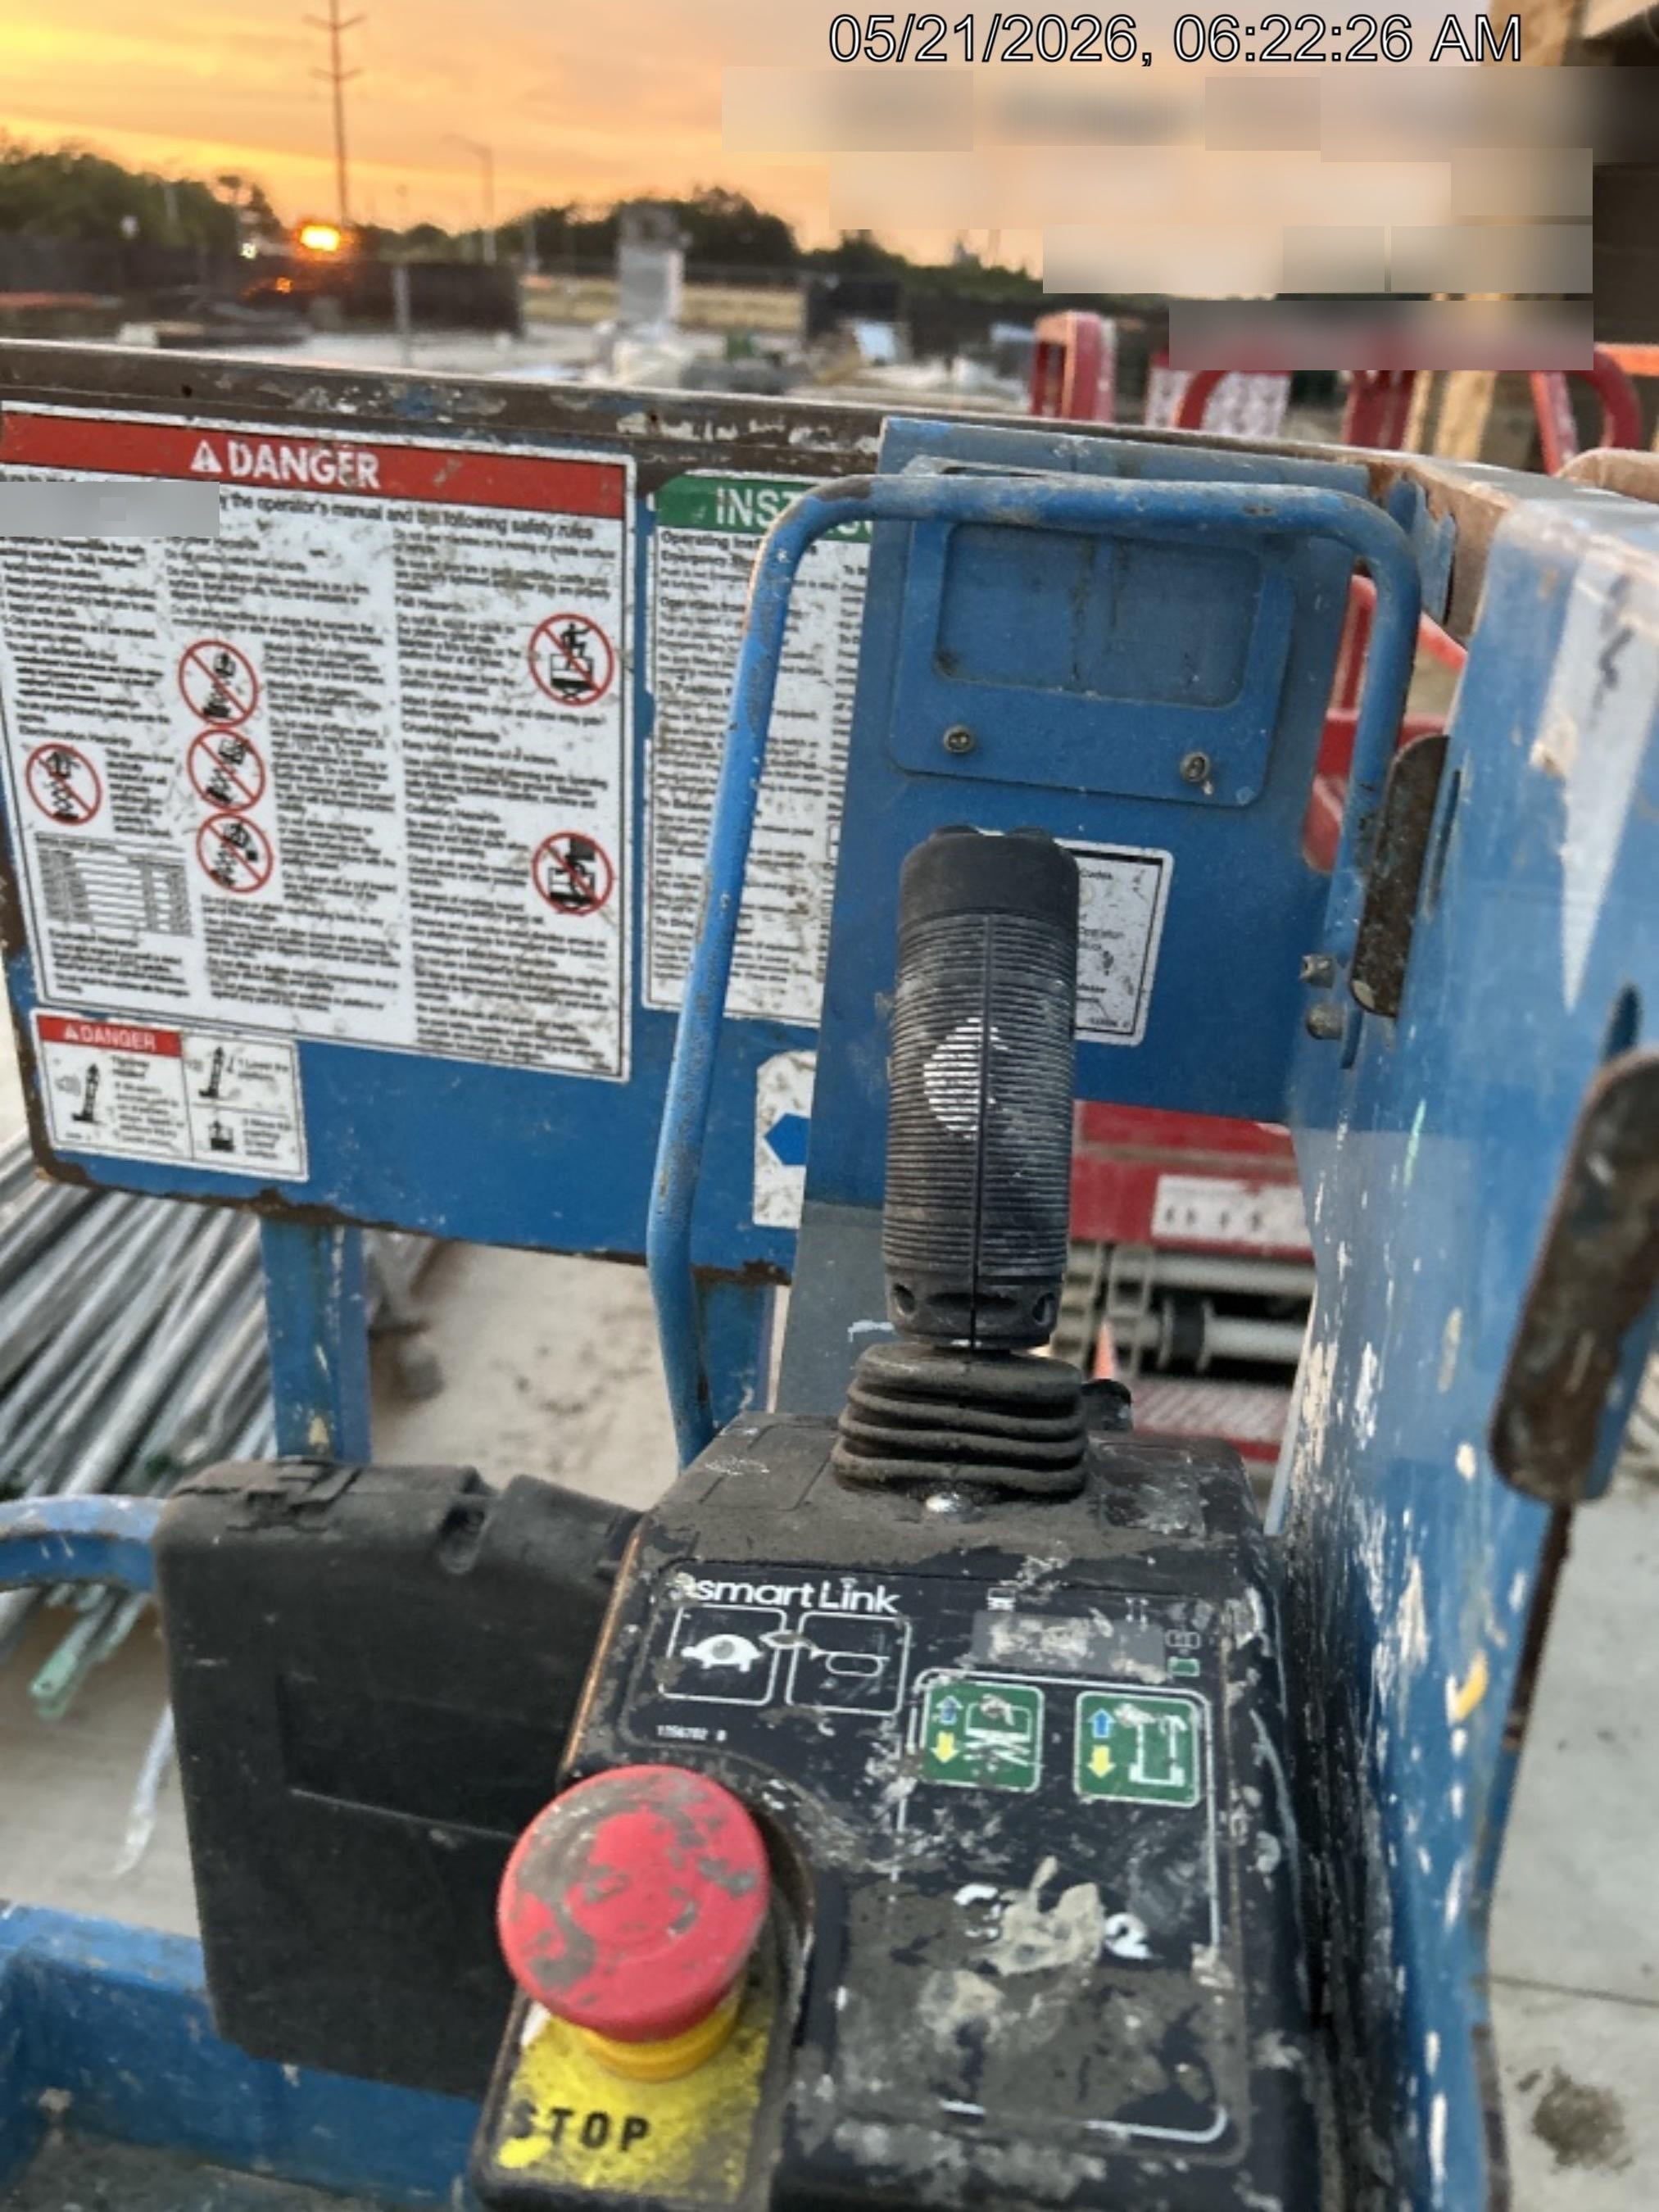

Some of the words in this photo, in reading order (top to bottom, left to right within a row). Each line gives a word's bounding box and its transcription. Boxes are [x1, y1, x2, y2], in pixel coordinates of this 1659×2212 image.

[227, 440, 382, 490] DANGER
[233, 492, 255, 510] the
[257, 497, 329, 518] operator's
[332, 503, 383, 521] manual
[387, 506, 412, 523] and
[442, 510, 509, 536] following
[511, 515, 557, 539] safety
[79, 1025, 157, 1052] DANGER
[506, 2097, 650, 2152] STOP
